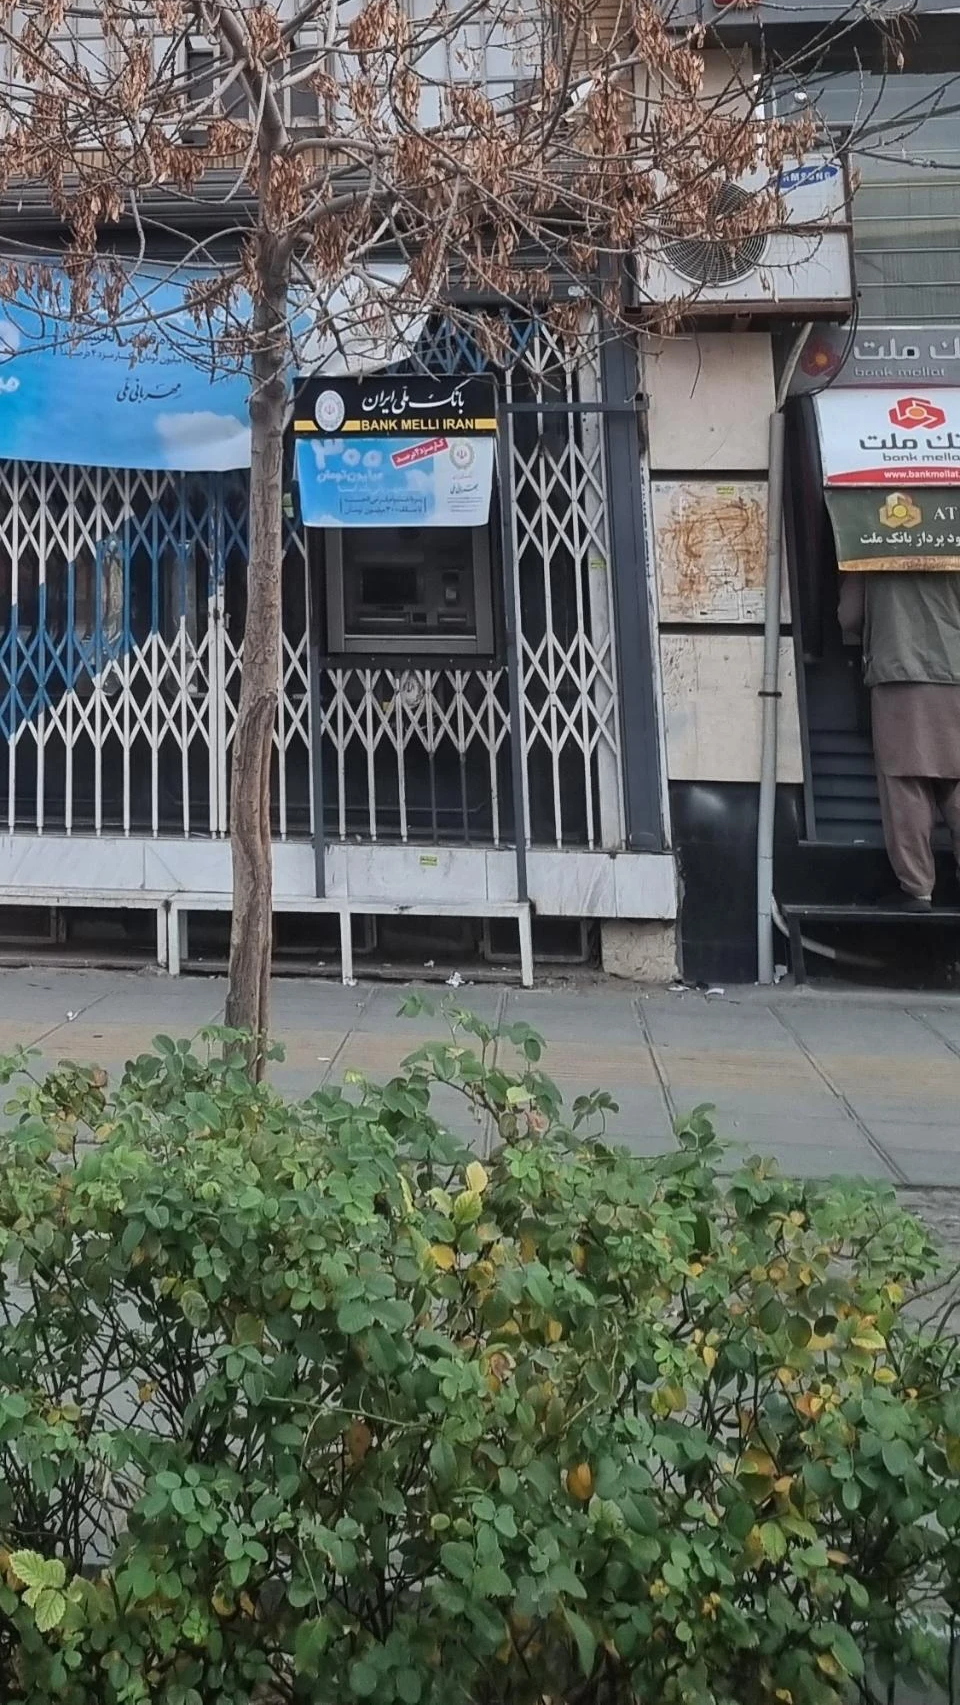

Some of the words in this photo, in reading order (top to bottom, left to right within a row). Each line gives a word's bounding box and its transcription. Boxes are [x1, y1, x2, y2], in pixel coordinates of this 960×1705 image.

[782, 171, 831, 183] AMSUNG
[854, 338, 920, 360] ملت
[361, 390, 396, 413] ایران
[409, 378, 473, 414] بانک
[361, 419, 398, 431] BANK
[401, 419, 440, 430] MELLI
[443, 418, 474, 429] IRAN
[859, 432, 918, 449] ملت
[883, 452, 918, 462] bank
[922, 452, 960, 462] mella
[933, 506, 958, 521] AT
[860, 531, 884, 544] ملت
[885, 531, 913, 546] بانک
